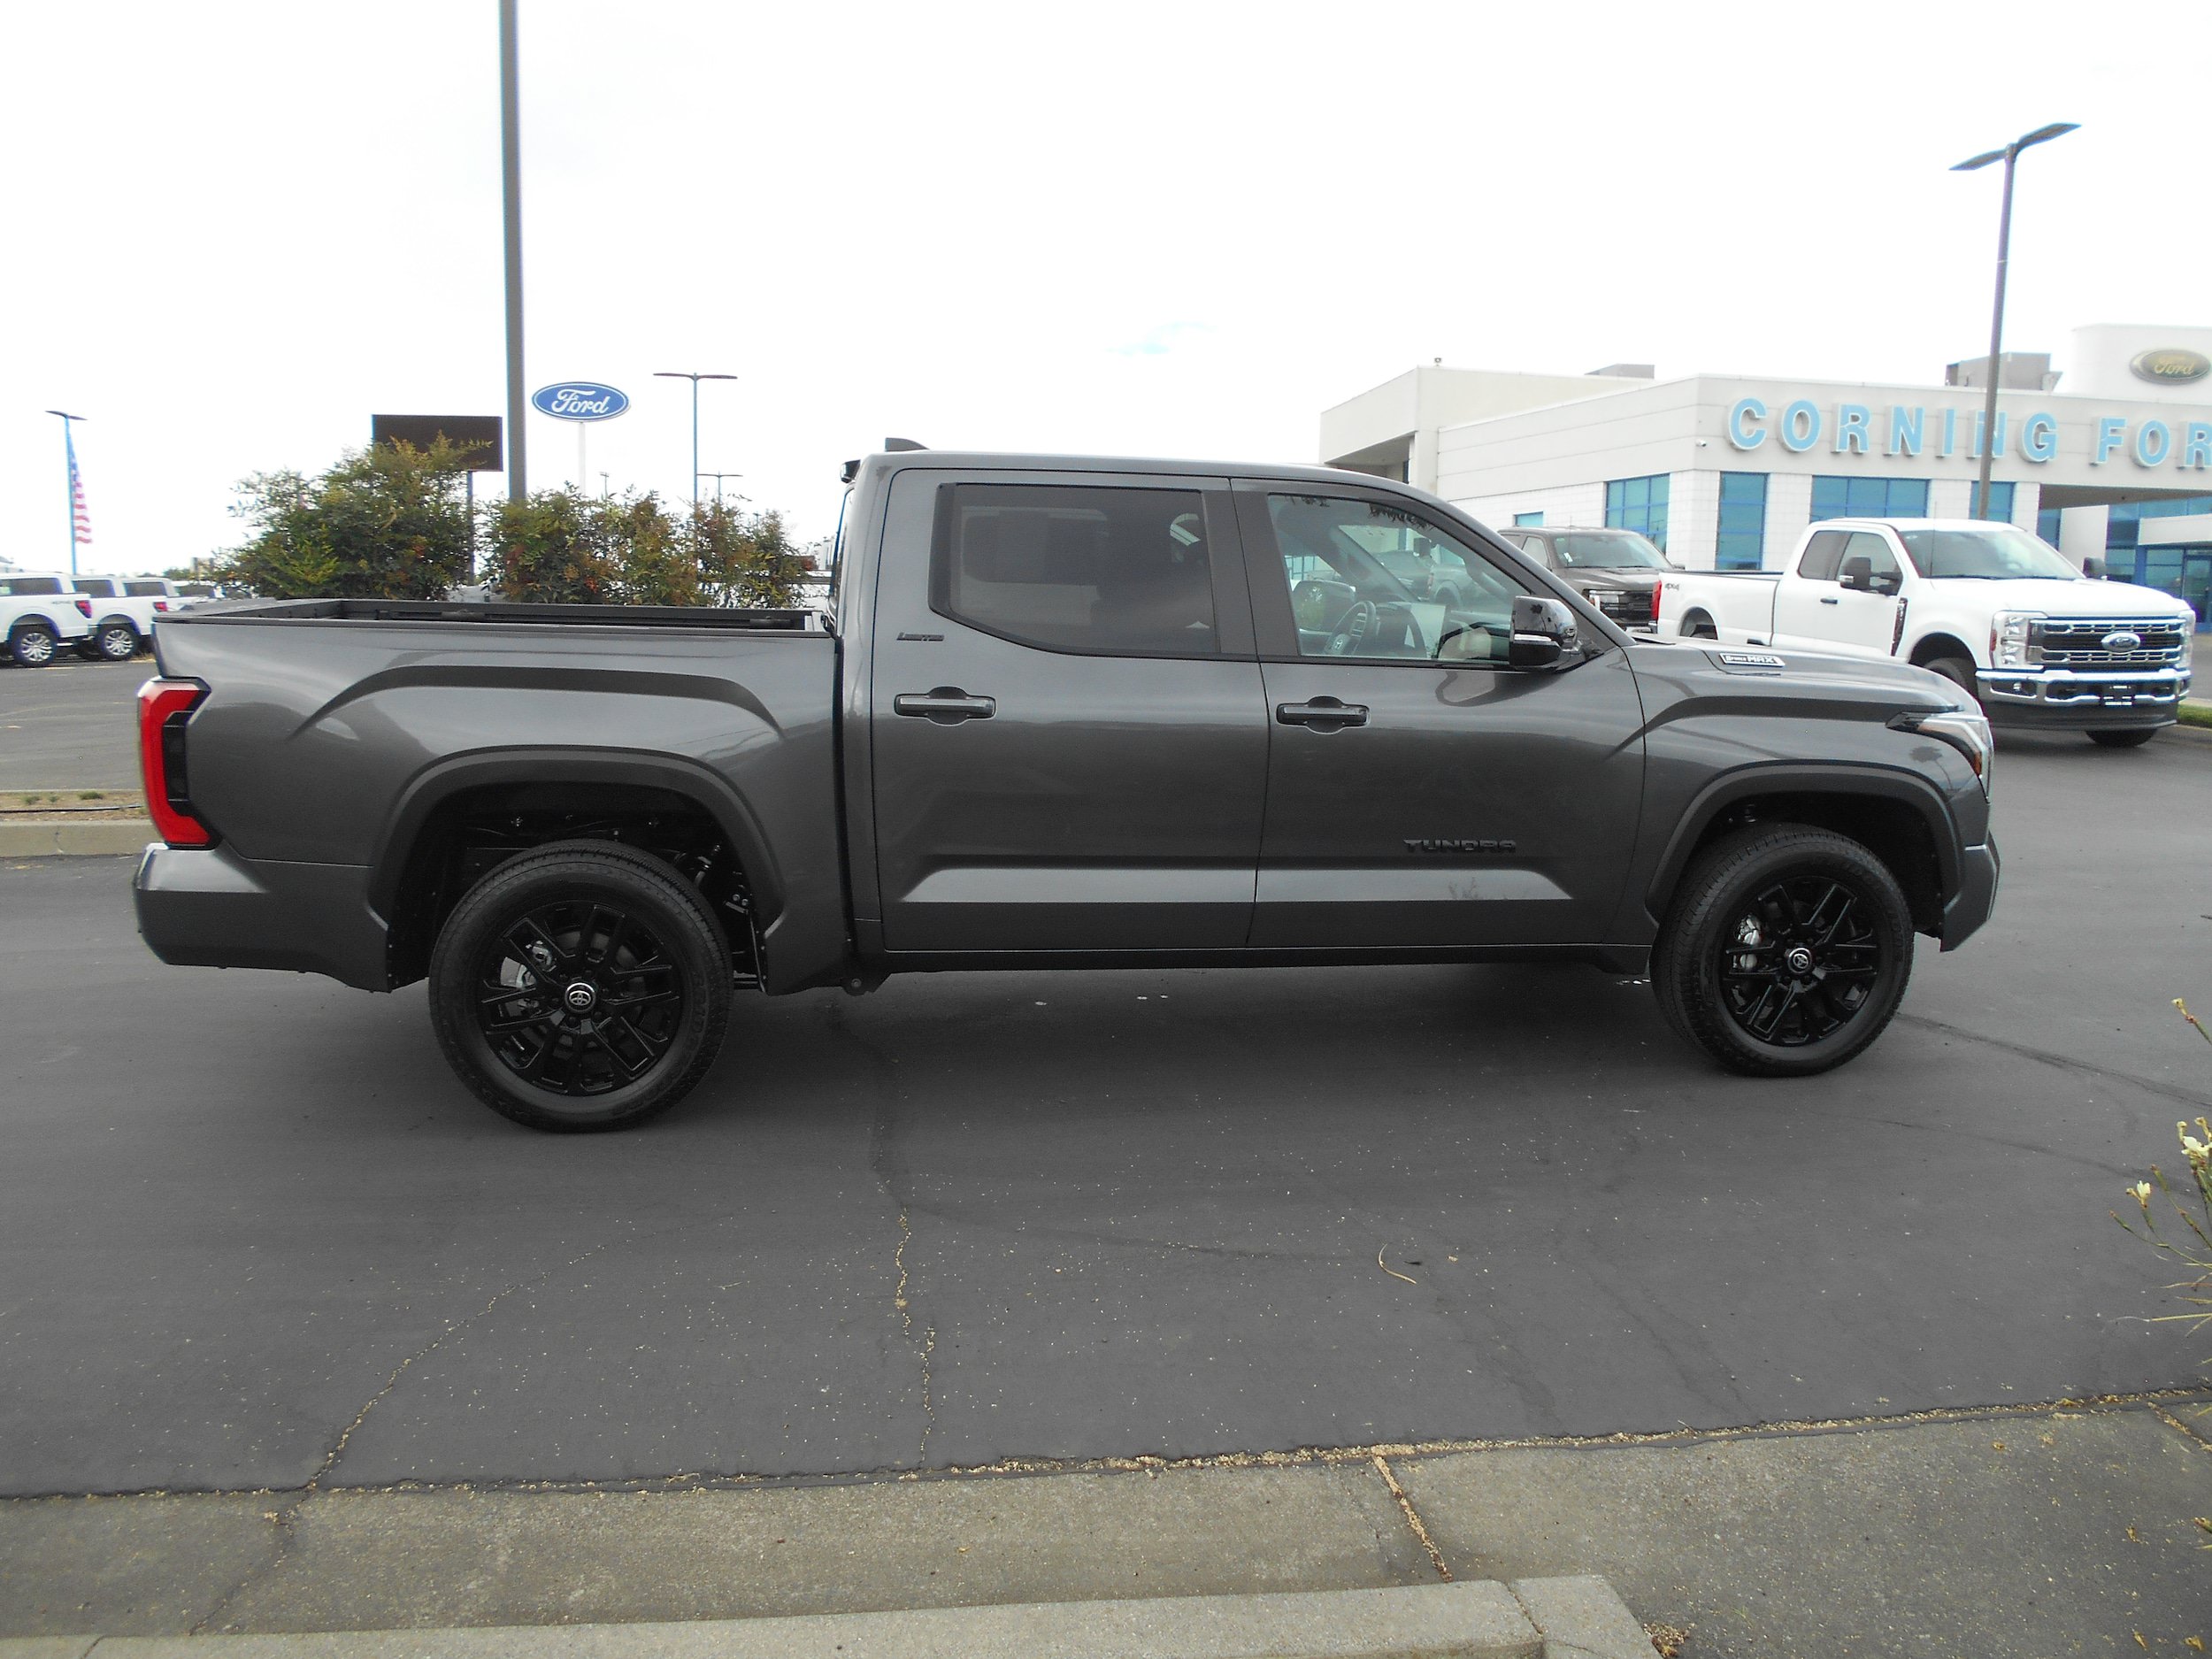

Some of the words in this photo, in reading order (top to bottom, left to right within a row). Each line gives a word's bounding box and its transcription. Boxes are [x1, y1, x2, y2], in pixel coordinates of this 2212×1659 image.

[2153, 356, 2195, 375] Ford
[551, 388, 611, 413] Ford
[1726, 396, 2059, 463] CORNING
[896, 632, 944, 641] LTED
[1403, 839, 1517, 853] TUNDRA
